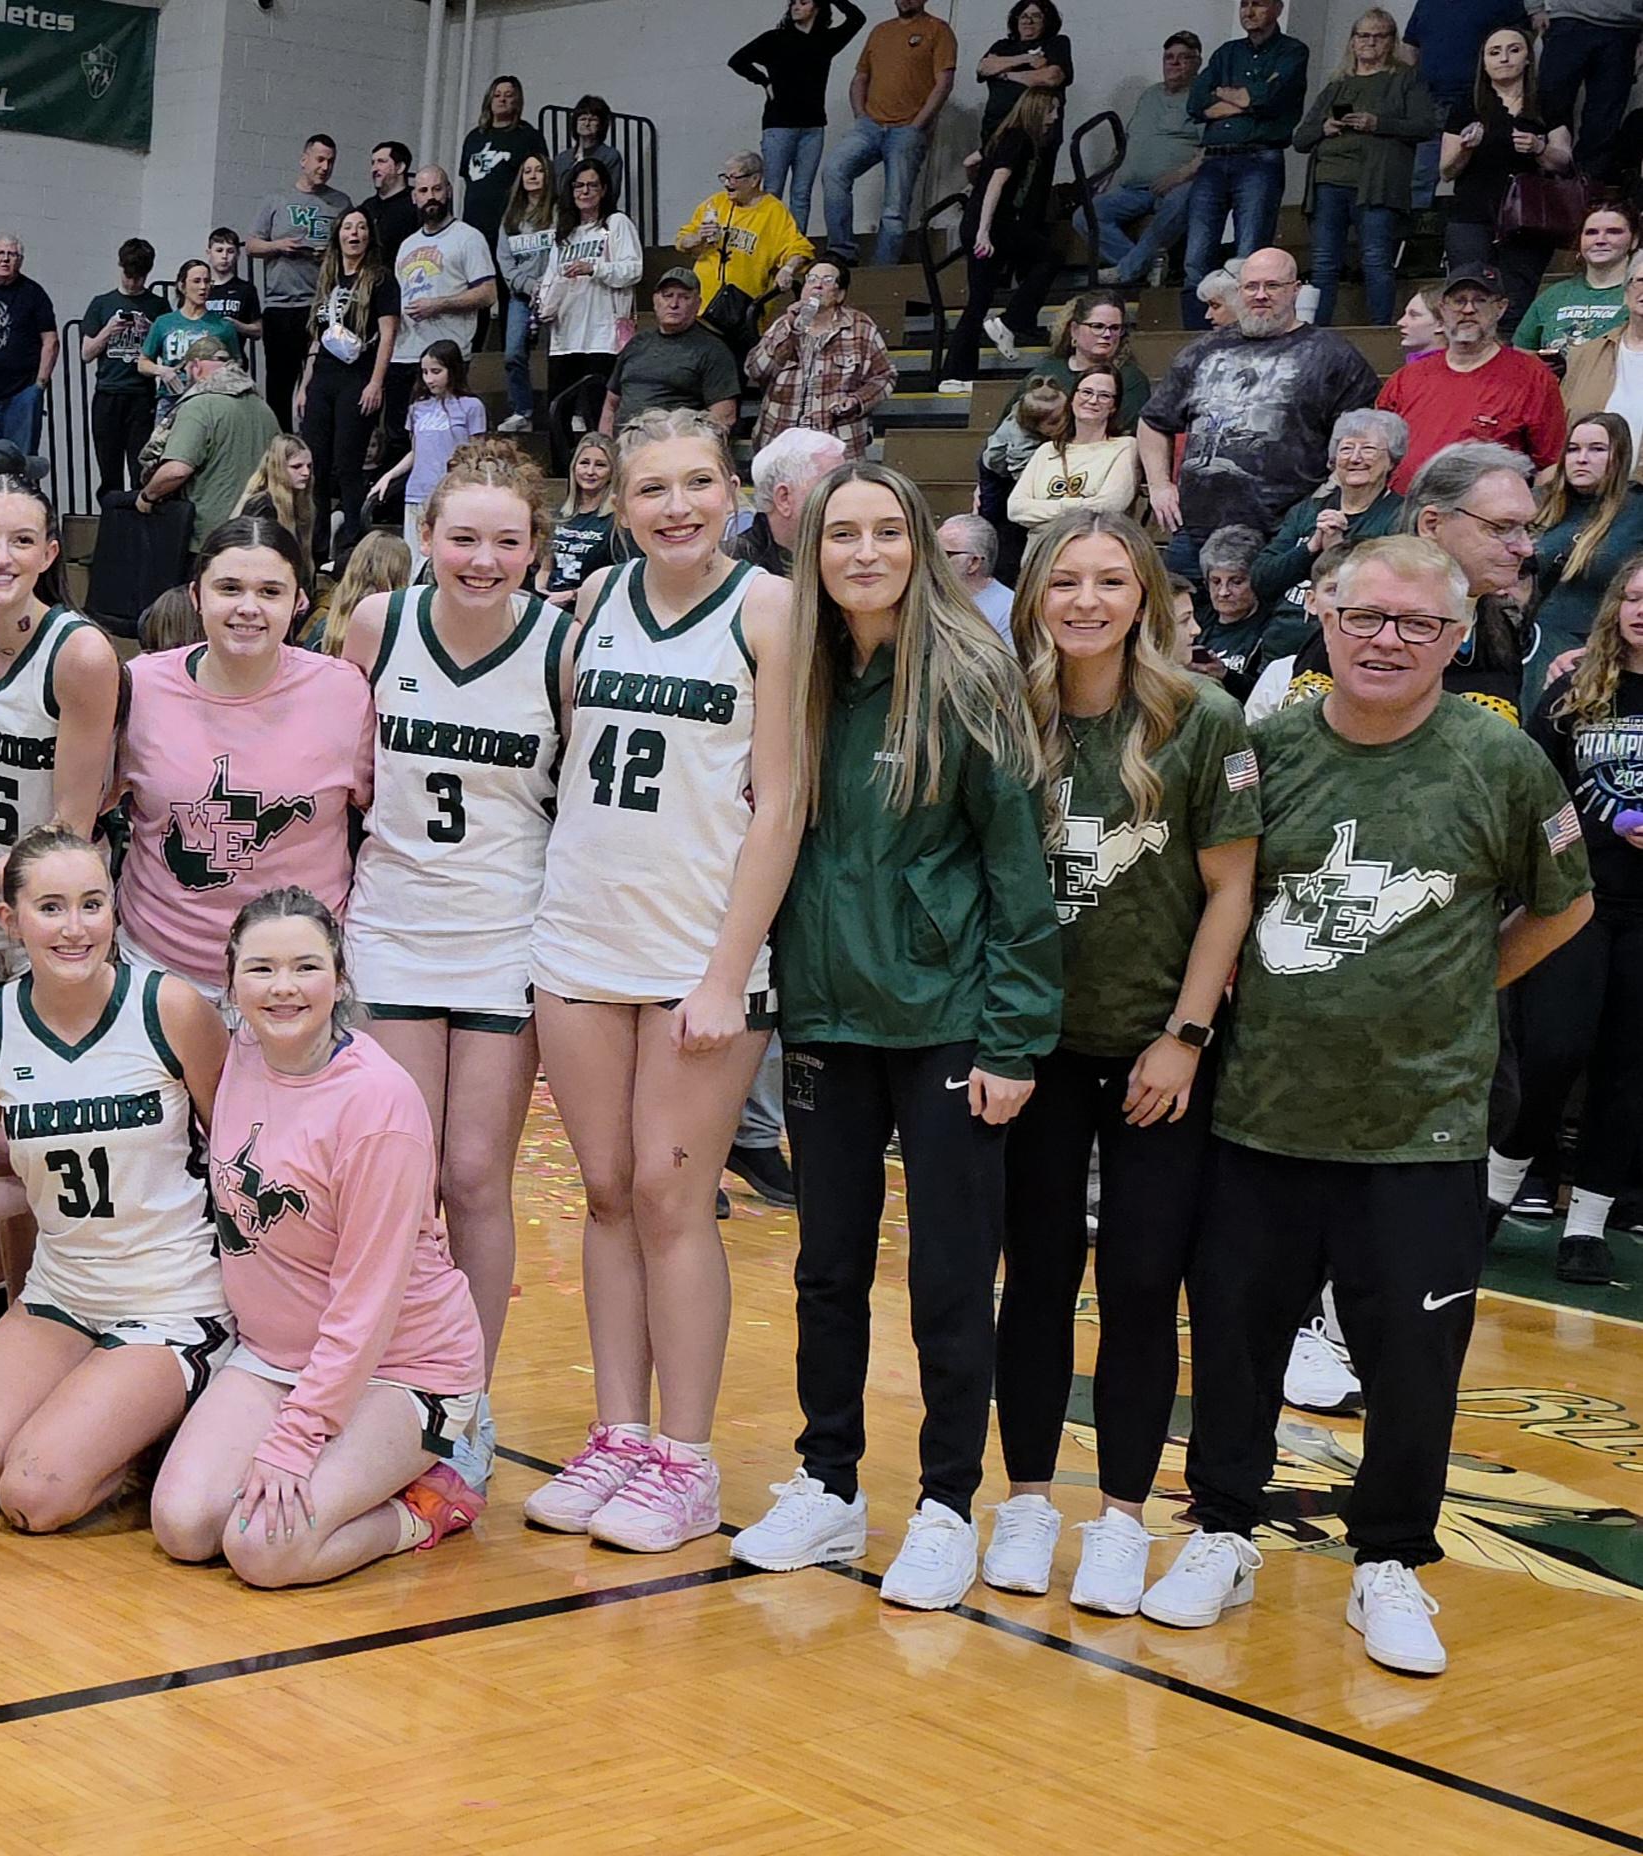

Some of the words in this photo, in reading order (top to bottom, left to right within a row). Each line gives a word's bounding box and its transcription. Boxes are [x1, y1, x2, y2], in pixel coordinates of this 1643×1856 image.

[287, 204, 330, 240] WE
[588, 725, 667, 813] 42
[170, 801, 258, 873] WE
[426, 772, 467, 844] 3
[1278, 873, 1377, 954] WE
[45, 1146, 115, 1218] 31
